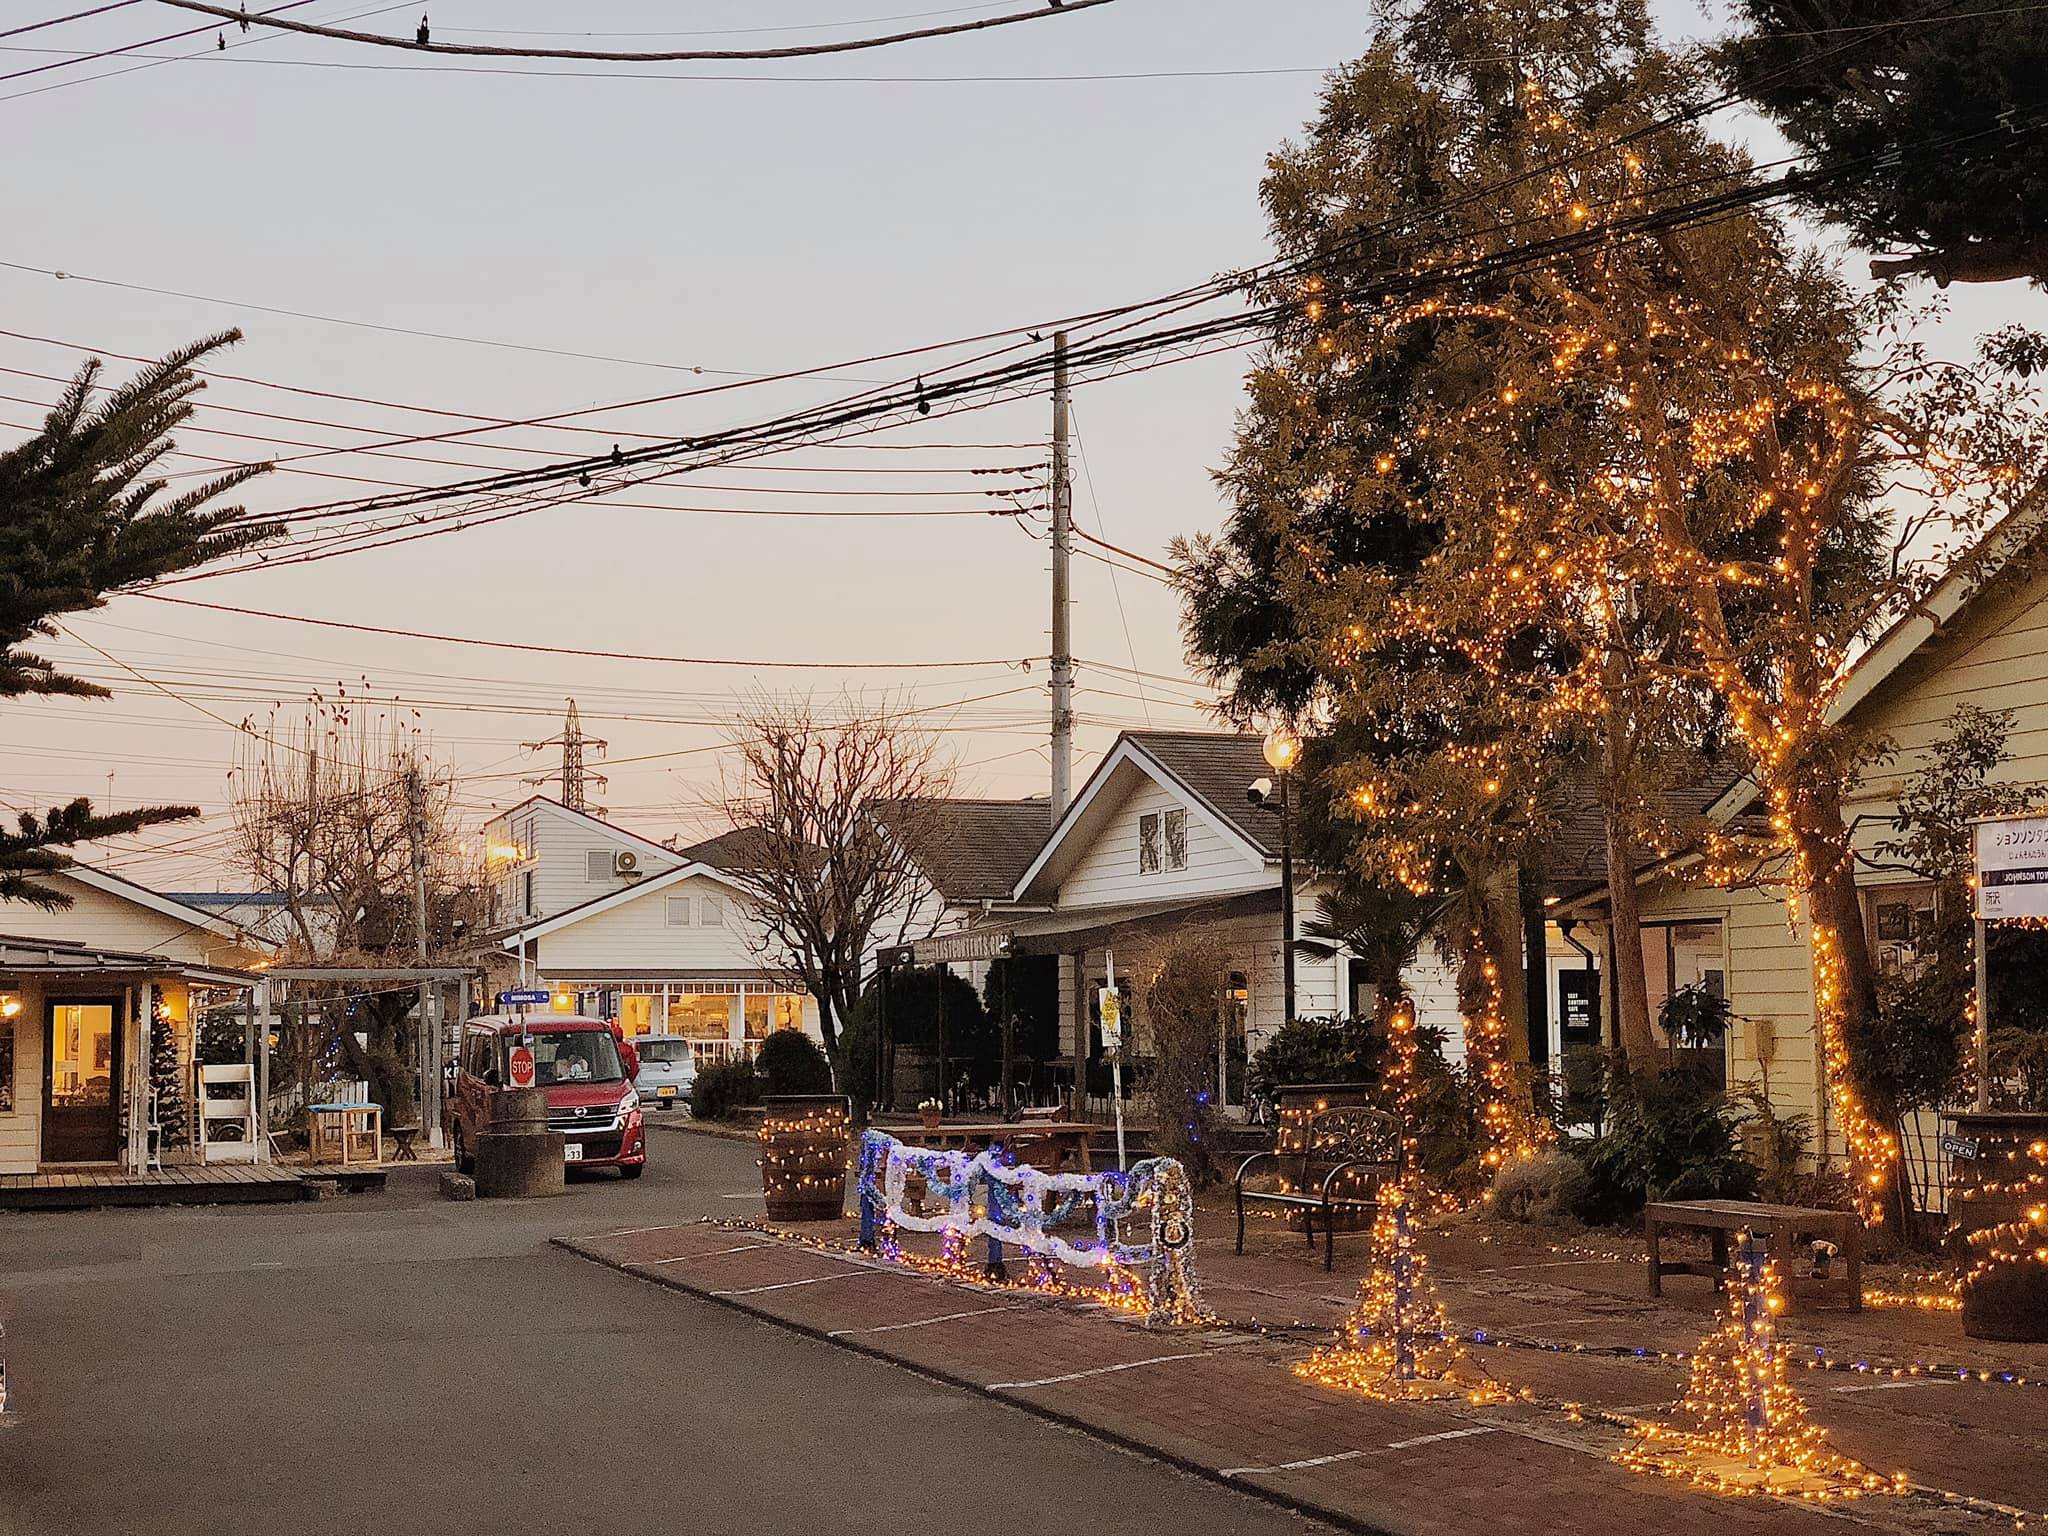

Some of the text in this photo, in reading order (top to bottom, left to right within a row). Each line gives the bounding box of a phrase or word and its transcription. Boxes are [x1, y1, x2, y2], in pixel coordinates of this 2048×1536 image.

[2004, 871, 2035, 882] JOHNSON
[512, 1061, 533, 1074] STOP
[1944, 1142, 1973, 1157] OPEN
